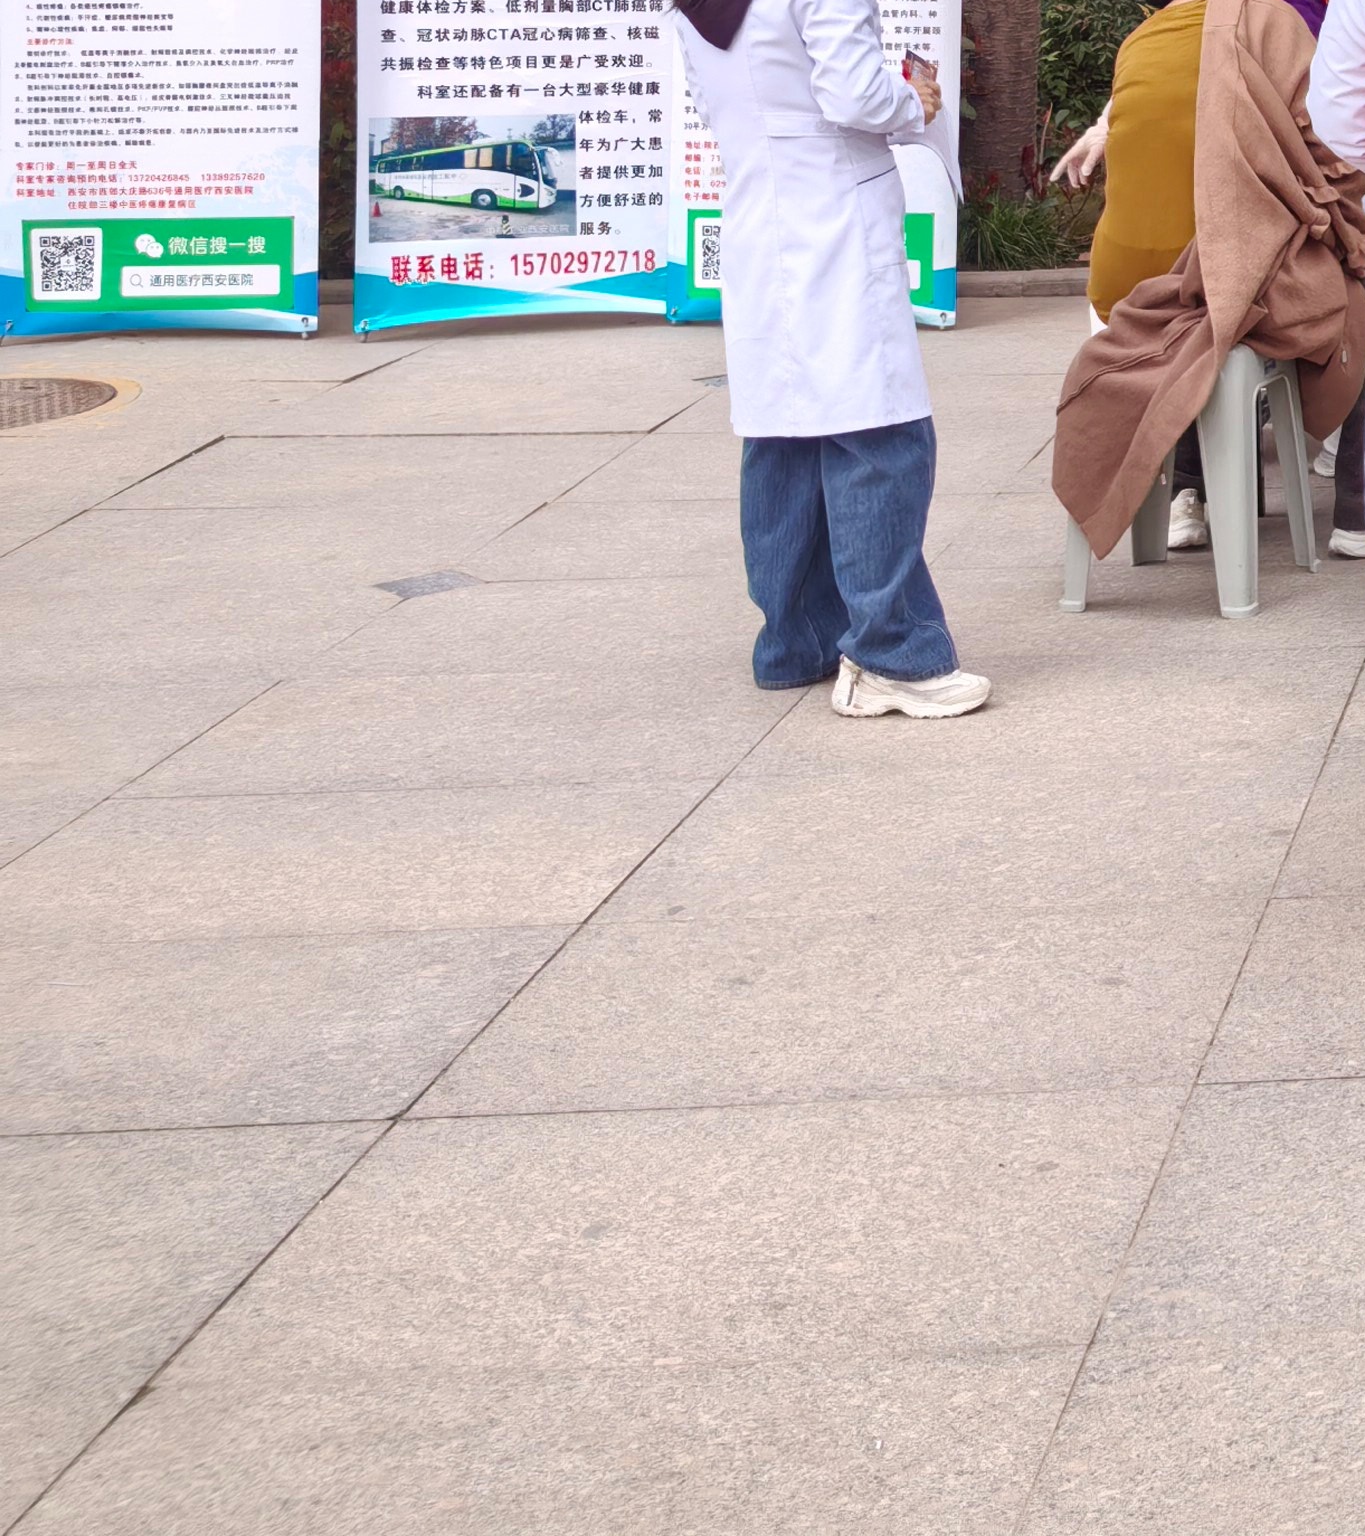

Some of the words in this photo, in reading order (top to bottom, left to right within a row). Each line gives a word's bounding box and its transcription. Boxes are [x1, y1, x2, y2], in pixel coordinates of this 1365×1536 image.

[579, 137, 663, 152] 年为广大患
[579, 164, 663, 180] 者提供更加
[579, 192, 663, 208] 方便舒适的
[168, 235, 267, 256] 微信搜一搜
[149, 272, 254, 288] 通用医疗西安医院
